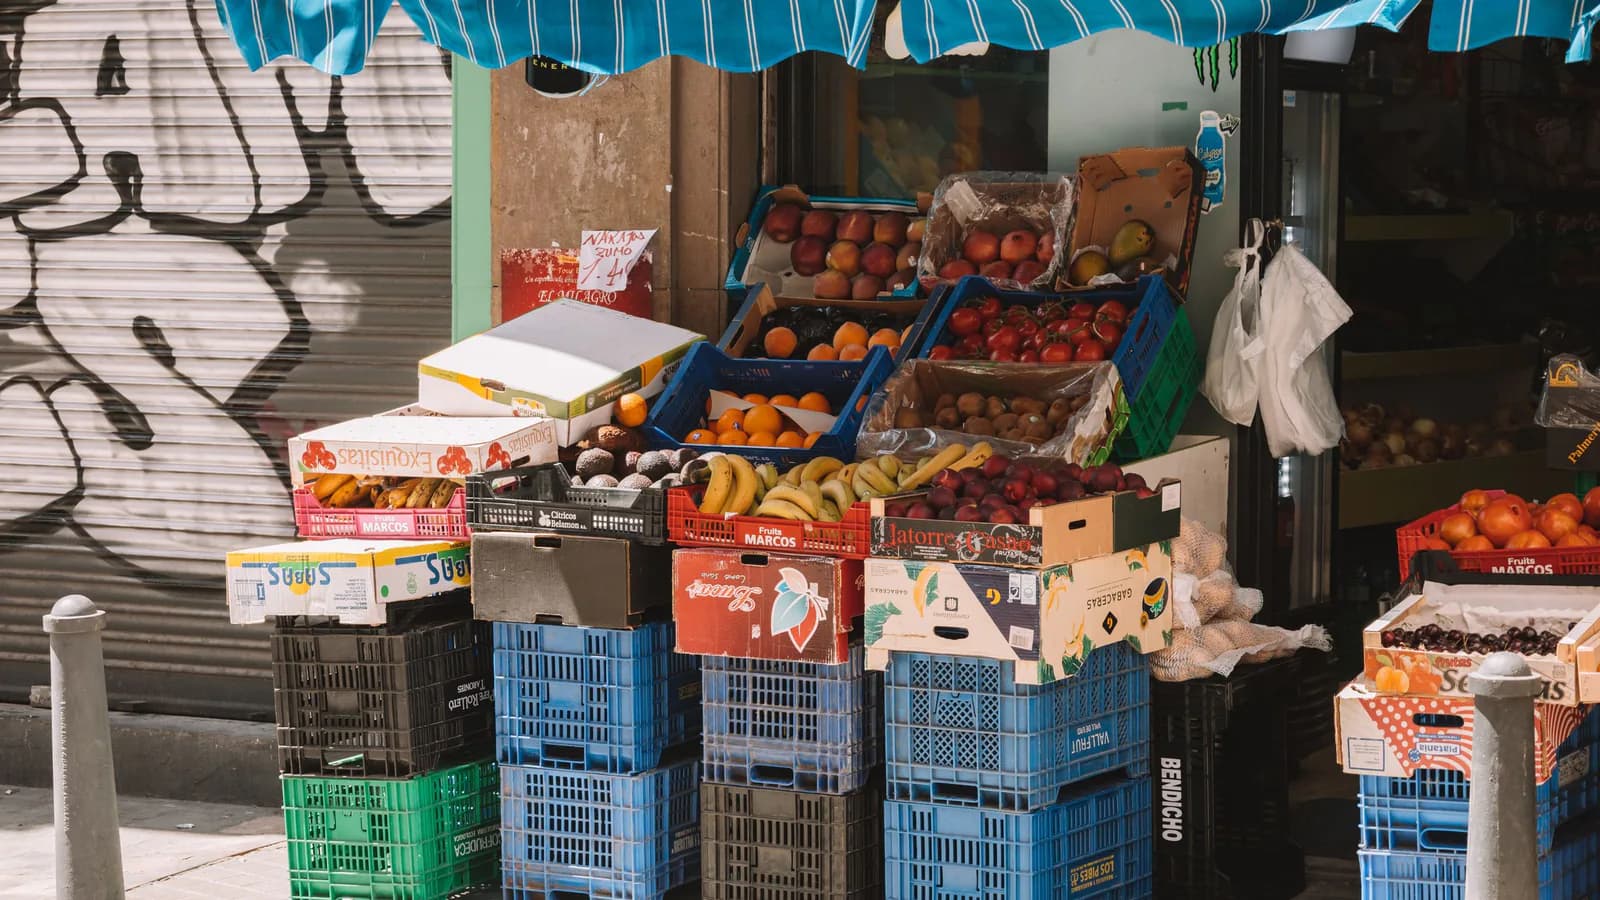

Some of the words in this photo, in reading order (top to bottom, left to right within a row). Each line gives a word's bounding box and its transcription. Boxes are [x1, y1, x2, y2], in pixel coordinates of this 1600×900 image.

[532, 58, 568, 70] ENER
[595, 246, 632, 258] ZUMO
[538, 290, 556, 303] EL
[557, 290, 617, 305] MILAGRO
[508, 425, 553, 454] Exquisitas
[338, 446, 432, 474] Exquisitas
[362, 521, 409, 533] MARCOS
[758, 526, 782, 536] Fruits
[744, 534, 797, 548] MARCOS
[426, 552, 471, 585] BAS
[1491, 565, 1554, 574] MARCOS
[1507, 557, 1536, 566] Fruits
[267, 562, 331, 586] SABAS
[1086, 588, 1133, 610] GABACERAS
[1071, 731, 1110, 754] VALLFRUT
[1160, 757, 1183, 843] BENDICHO
[1080, 865, 1100, 882] PIBES
[1100, 860, 1114, 876] LOS
